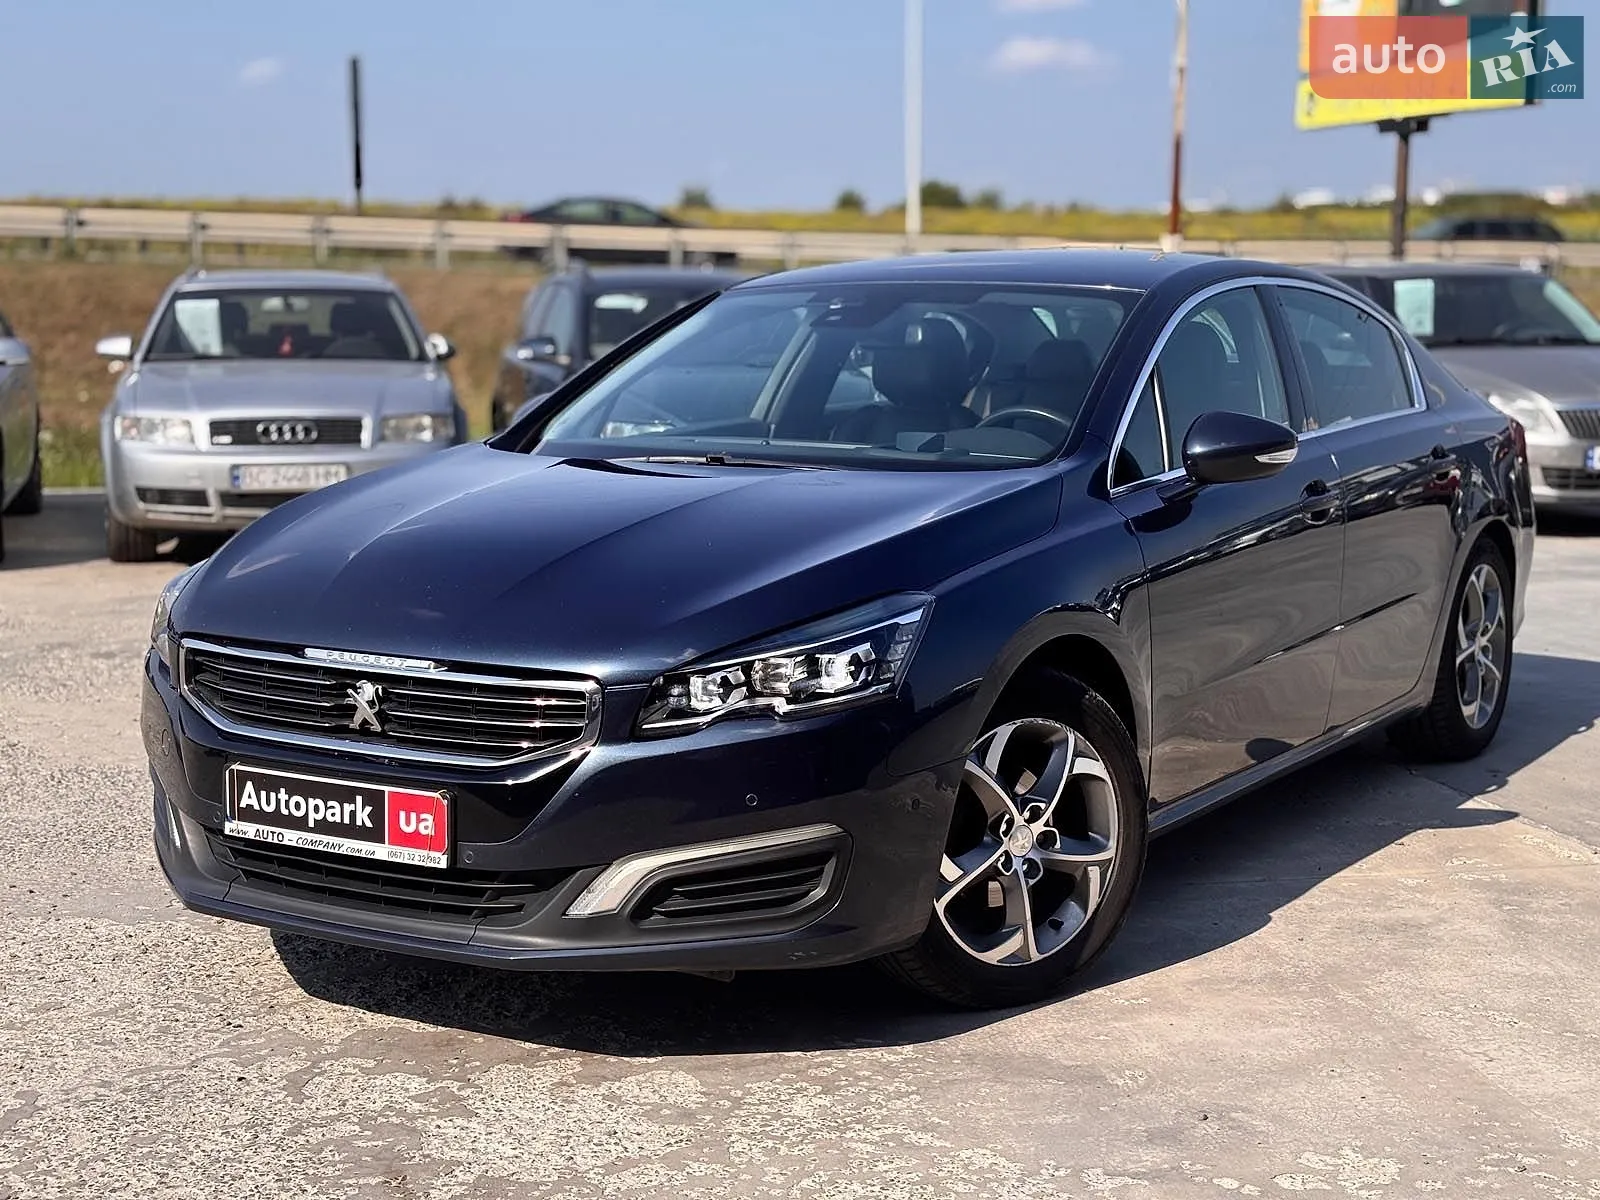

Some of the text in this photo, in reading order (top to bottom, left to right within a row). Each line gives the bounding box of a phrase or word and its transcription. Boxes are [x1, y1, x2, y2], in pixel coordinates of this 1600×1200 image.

[326, 650, 407, 667] PEUGEOT
[239, 780, 436, 836] Autopark ua
[253, 828, 285, 843] AUTO
